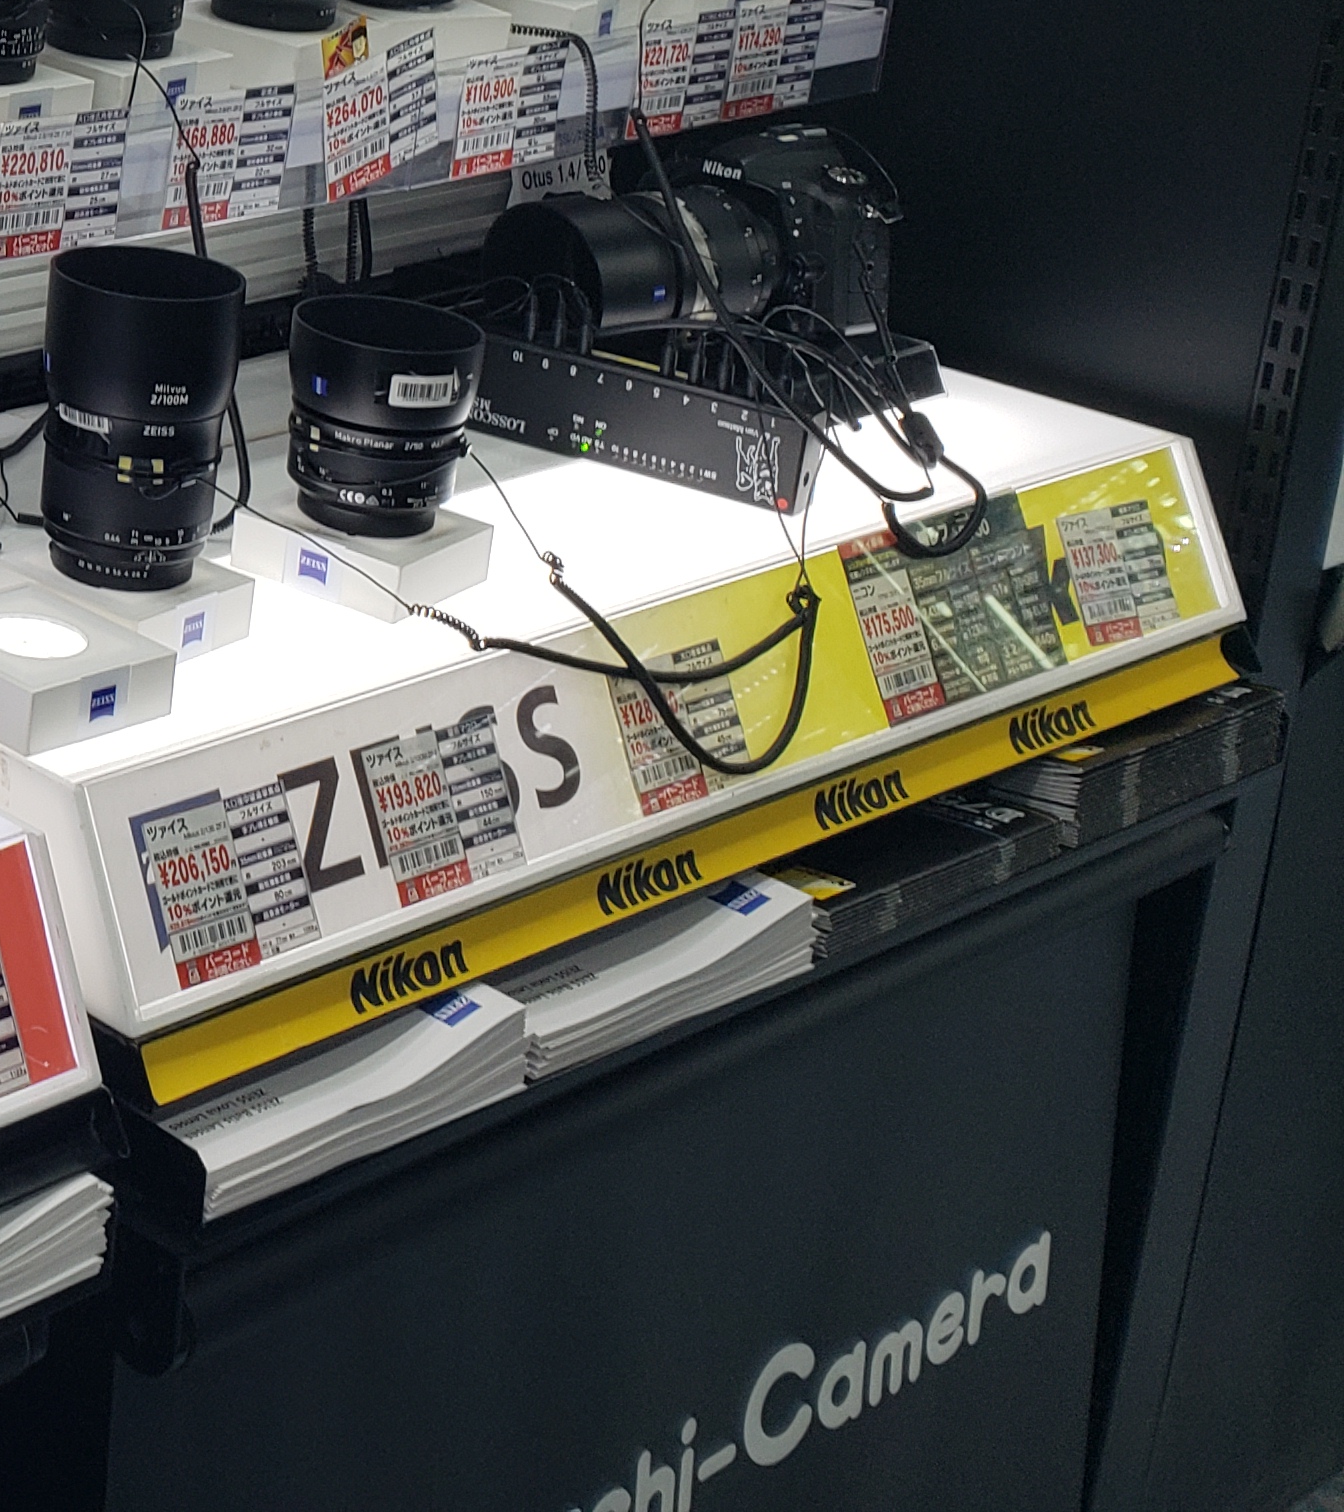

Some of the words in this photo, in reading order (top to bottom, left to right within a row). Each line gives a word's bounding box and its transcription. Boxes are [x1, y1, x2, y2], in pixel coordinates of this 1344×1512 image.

[522, 170, 553, 190] Otus
[703, 159, 742, 180] Nikon
[150, 393, 189, 406] 2/100M
[143, 425, 175, 437] ZEISS
[300, 556, 327, 570] ZEISS
[1008, 698, 1097, 756] Nikon
[814, 769, 909, 830] Nikon
[597, 846, 702, 916] Nikon
[350, 937, 469, 1013] Nikon
[562, 1230, 1052, 1512] hi-Camera
